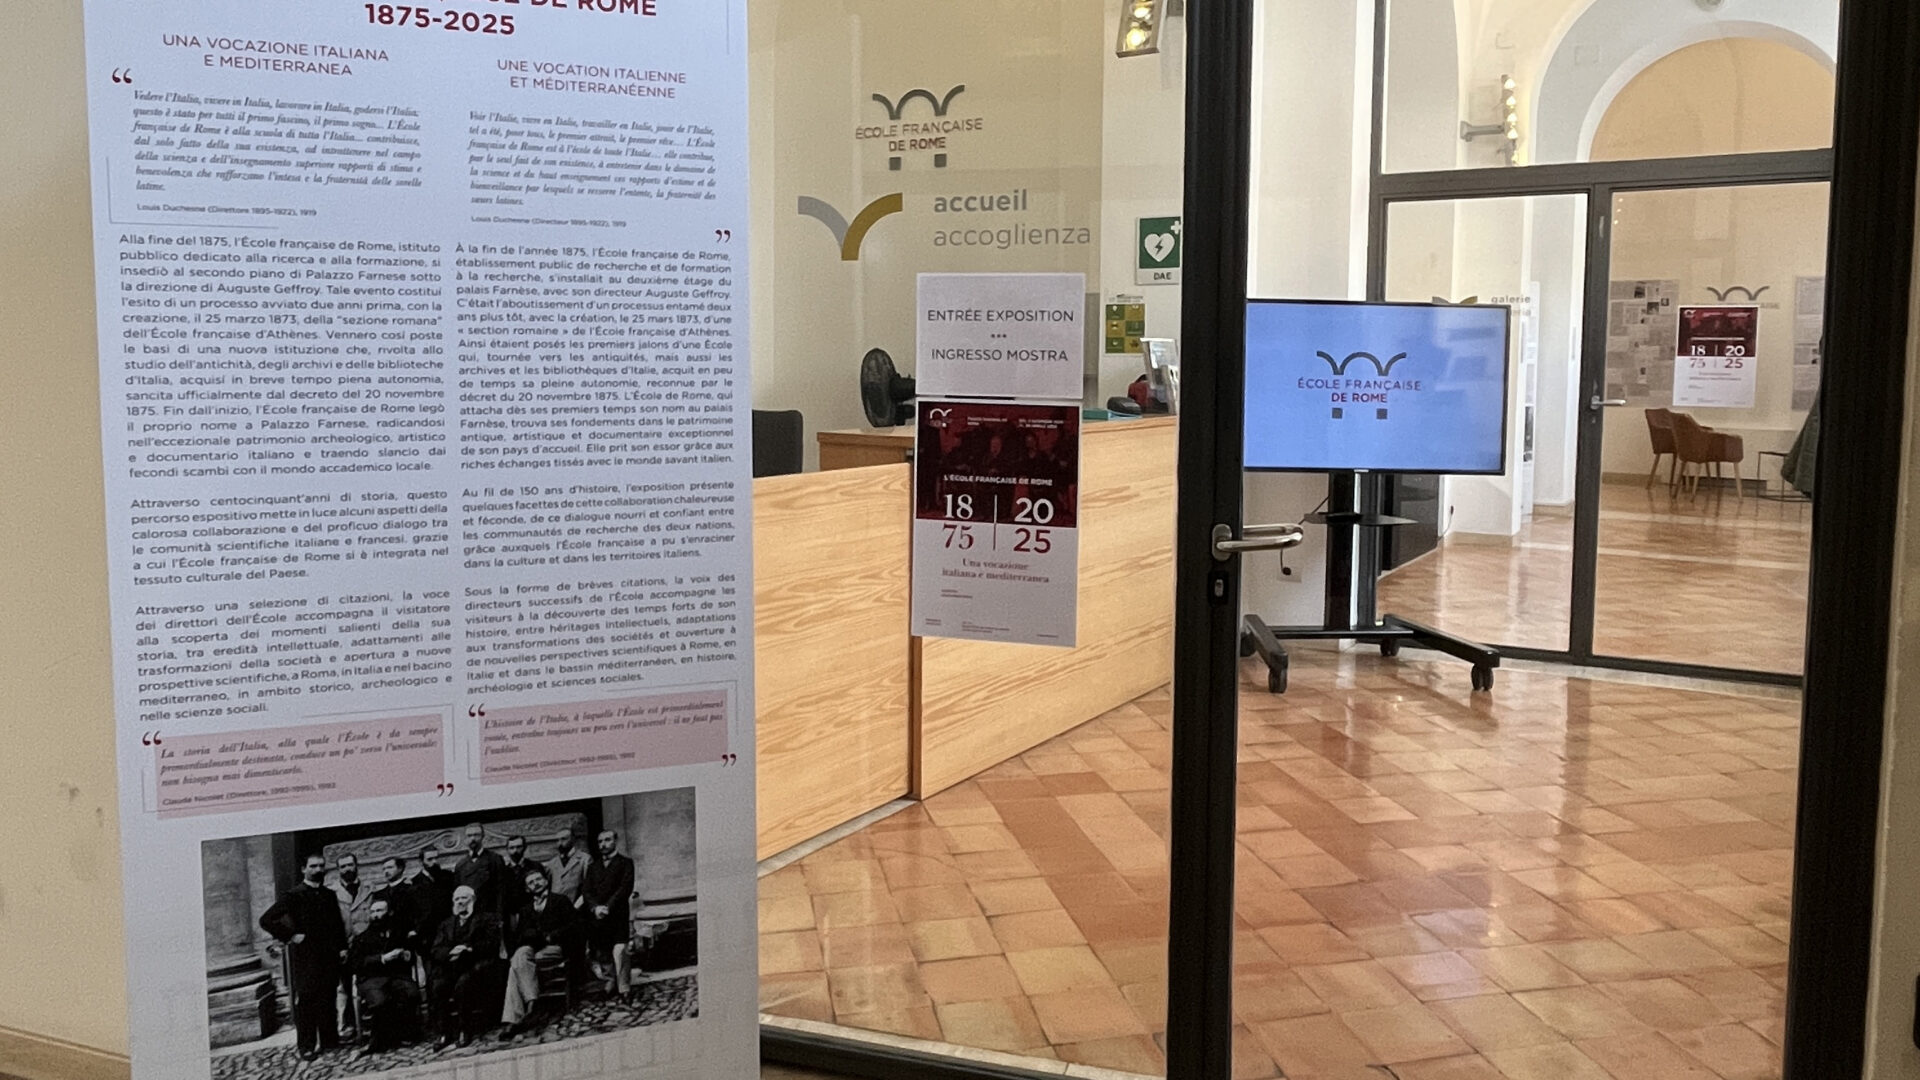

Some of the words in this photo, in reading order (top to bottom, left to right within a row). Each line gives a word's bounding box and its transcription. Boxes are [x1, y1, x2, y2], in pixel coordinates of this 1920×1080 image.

[365, 3, 515, 35] 1875-2025
[163, 34, 201, 49] UNA
[207, 37, 309, 57] VOCAZIONE
[314, 45, 389, 61] ITALIANA
[204, 54, 213, 67] E
[219, 57, 353, 76] MEDITERRANEA
[497, 59, 529, 73] UNE
[533, 62, 610, 78] VOCATION
[614, 68, 687, 84] ITALIENNE
[510, 76, 527, 89] ET
[533, 76, 676, 99] MÉDITERRANÉENNE
[855, 125, 898, 139] ÉCOLE
[902, 117, 983, 136] FRANÇAISE
[889, 138, 905, 151] DE
[909, 137, 946, 150] ROME
[934, 189, 1027, 213] accueil
[119, 234, 145, 244] Alla
[147, 234, 173, 245] fine
[175, 236, 196, 245] del
[199, 236, 231, 247] 1875,
[279, 238, 336, 250] française
[338, 240, 354, 250] de
[357, 240, 396, 252] Rome,
[398, 242, 441, 252] istituto
[934, 224, 1090, 249] accoglienza
[119, 250, 179, 261] pubblico
[182, 251, 241, 262] dedicato
[245, 253, 267, 263] alla
[271, 256, 314, 264] ricerca
[330, 255, 352, 265] alla
[356, 255, 427, 267] formazione,
[538, 260, 573, 270] public
[576, 261, 591, 270] de
[593, 262, 647, 271] recherche
[664, 263, 678, 272] de
[680, 263, 732, 273] formation
[1153, 272, 1172, 280] DAE
[1491, 294, 1531, 304] galerie
[928, 308, 982, 322] ENTRÉE
[987, 310, 1074, 322] EXPOSITION
[931, 349, 1002, 361] INGRESSO
[1007, 350, 1068, 361] MOSTRA
[1690, 345, 1706, 356] 18
[1725, 345, 1745, 357] 20
[458, 366, 506, 375] archives
[508, 366, 520, 374] et
[523, 366, 540, 374] les
[661, 366, 694, 375] acquit
[713, 367, 733, 375] peu
[1689, 358, 1706, 368] 75
[1724, 358, 1743, 369] 25
[1298, 377, 1340, 389] ÉCOLE
[1345, 380, 1421, 391] FRANÇAISE
[125, 391, 173, 400] sancita
[177, 390, 262, 400] ufficialmente
[266, 389, 285, 399] dal
[289, 390, 338, 399] decreto
[341, 389, 360, 398] del
[364, 389, 381, 398] 20
[384, 389, 444, 398] novembre
[1331, 393, 1347, 403] DE
[1352, 393, 1387, 403] ROME
[236, 436, 306, 446] patrimonio
[310, 433, 393, 444] archeologico,
[397, 433, 446, 442] artistico
[128, 467, 178, 478] fecondi
[182, 466, 229, 476] scambi
[232, 467, 256, 475] con
[260, 465, 267, 474] il
[270, 464, 316, 474] mondo
[318, 463, 392, 473] accademico
[975, 476, 1017, 484] FRANÇAISE
[1030, 478, 1053, 486] ROME
[130, 499, 200, 508] Attraverso
[340, 492, 351, 502] di
[360, 492, 398, 501] storia,
[406, 490, 447, 501] questo
[461, 488, 478, 497] Au
[483, 488, 494, 496] fil
[499, 488, 514, 496] de
[519, 486, 539, 495] 150
[945, 494, 974, 520] 18
[1014, 497, 1054, 524] 20
[131, 529, 187, 539] calorosa
[192, 526, 286, 537] collaborazione
[290, 525, 299, 533] e
[303, 522, 322, 532] del
[327, 521, 378, 533] proficuo
[382, 520, 428, 530] dialogo
[431, 518, 448, 528] tra
[942, 524, 975, 550] 75
[1013, 528, 1052, 554] 25
[962, 558, 981, 567] Una
[983, 560, 1029, 570] vocazione
[133, 575, 182, 585] tessuto
[185, 571, 242, 582] culturale
[245, 569, 265, 579] del
[269, 569, 311, 578] Paese.
[942, 568, 976, 578] italiana
[986, 572, 1049, 583] mediterranea
[135, 604, 205, 615] Attraverso
[214, 603, 238, 611] una
[248, 599, 307, 609] selezione
[317, 596, 328, 605] di
[338, 593, 392, 604] citazioni,
[402, 590, 412, 600] la
[464, 600, 522, 610] directeurs
[528, 594, 583, 606] successifs
[588, 594, 603, 602] de
[649, 588, 716, 599] accompagne
[135, 621, 156, 631] dei
[164, 617, 218, 629] direttori
[294, 609, 374, 621] accompagna
[381, 606, 388, 616] il
[395, 605, 450, 614] visitatore
[536, 680, 547, 688] et
[551, 677, 596, 688] sciences
[599, 673, 644, 683] sociales.
[139, 711, 171, 721] nelle
[174, 708, 223, 719] scienze
[277, 738, 297, 748] alla
[304, 736, 330, 747] quale
